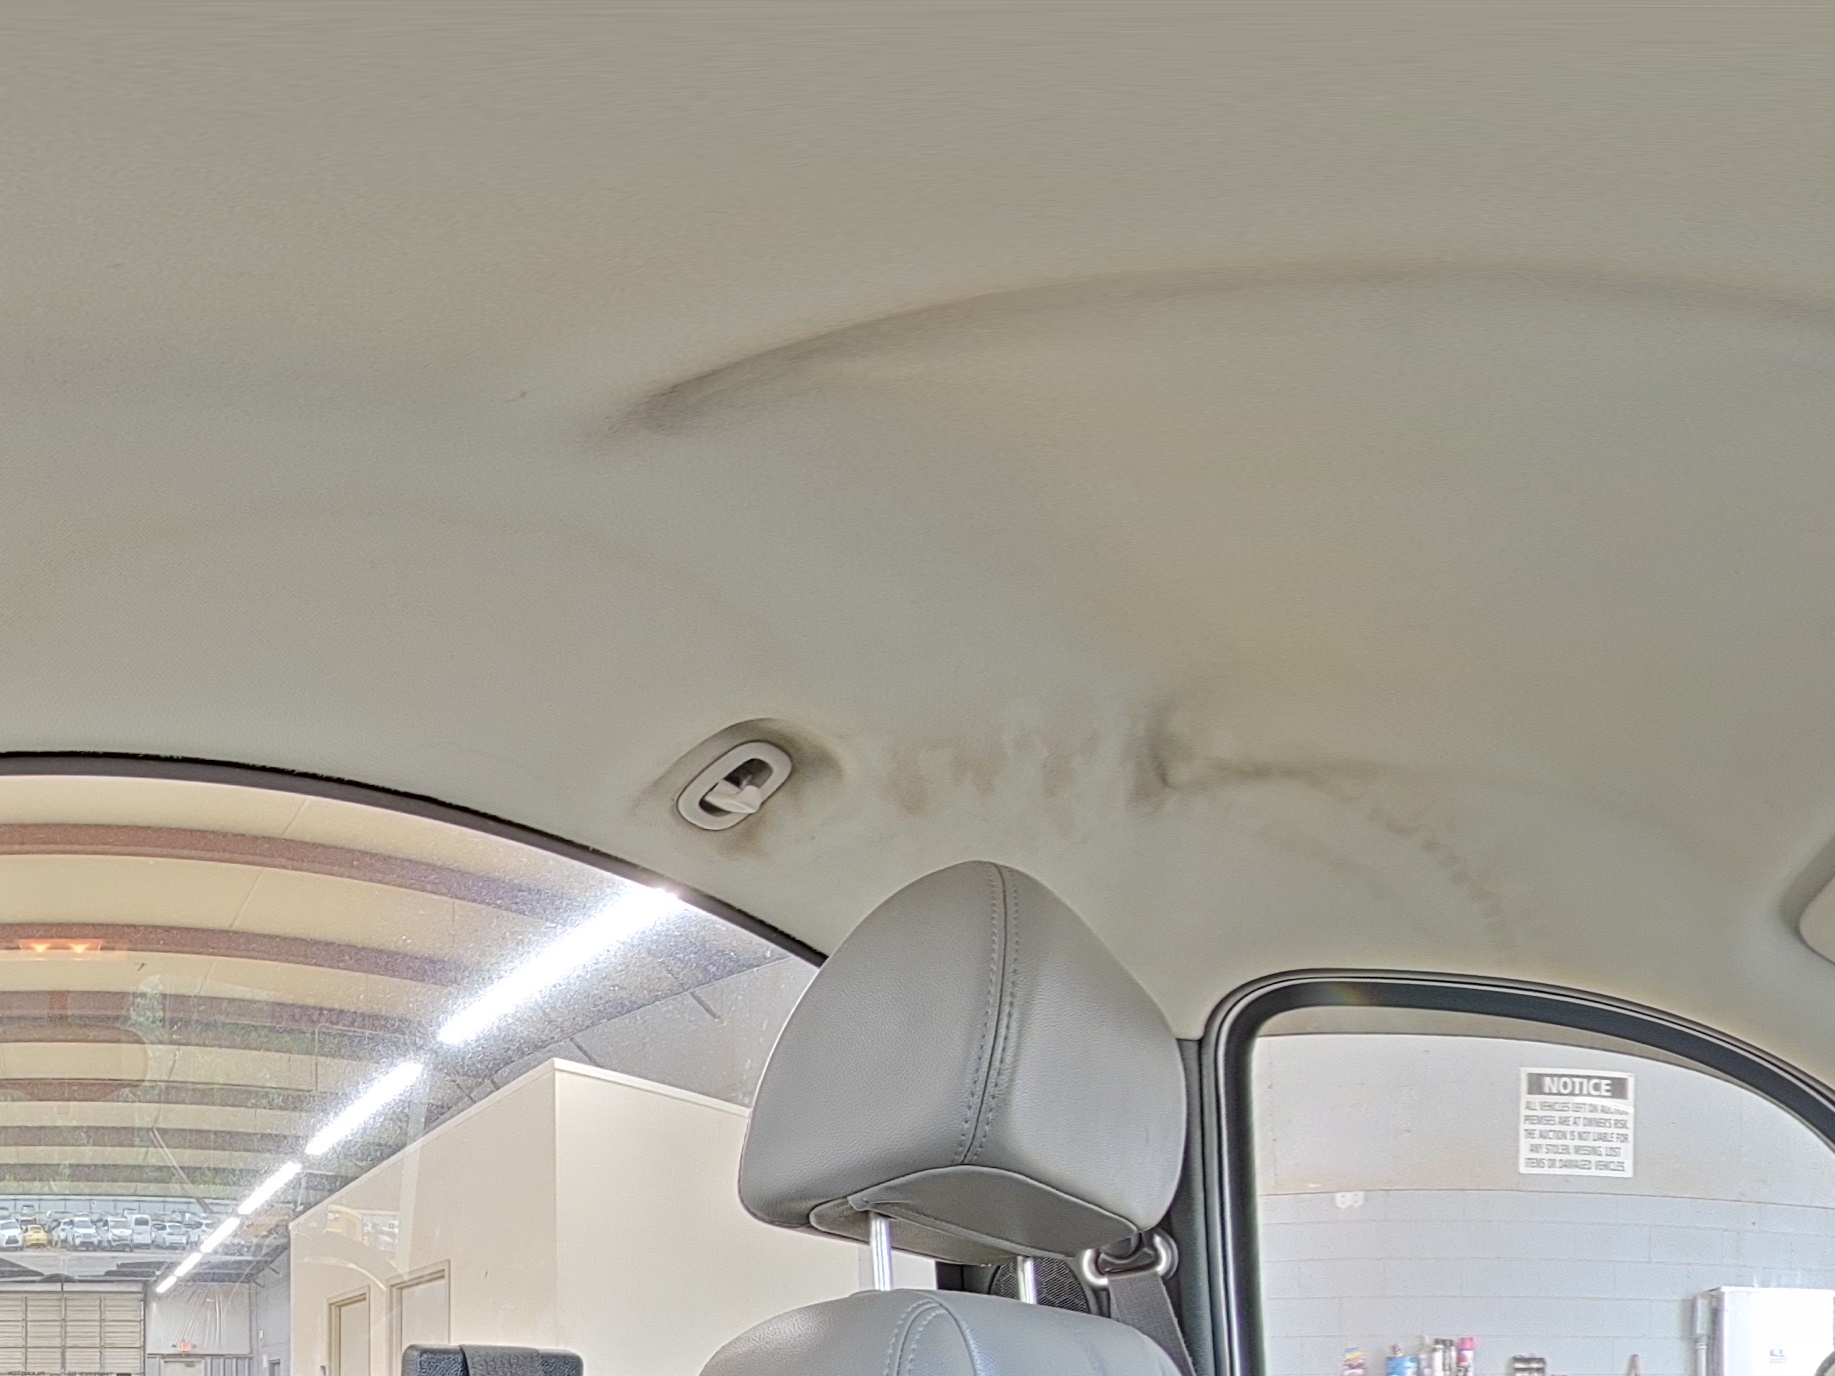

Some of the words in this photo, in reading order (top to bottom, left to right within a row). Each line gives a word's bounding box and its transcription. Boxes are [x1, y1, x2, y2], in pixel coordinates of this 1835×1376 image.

[1543, 1076, 1612, 1096] NOTICE
[1525, 1101, 1538, 1111] ALL
[1539, 1101, 1570, 1112] VEHICLES
[1571, 1102, 1587, 1113] LEFT
[1588, 1103, 1599, 1113] ON
[1523, 1115, 1556, 1126] PREMISES
[1558, 1116, 1572, 1126] ARE
[1572, 1116, 1582, 1126] AT
[1523, 1129, 1537, 1139] THE
[1538, 1129, 1568, 1140] AUCTION
[1568, 1130, 1576, 1140] IS
[1577, 1130, 1591, 1141] NOT
[1592, 1131, 1614, 1142] LIABLE
[1615, 1132, 1629, 1143] FOR
[1529, 1143, 1543, 1154] ANY
[1604, 1146, 1622, 1157] LOST
[1525, 1158, 1545, 1168] ITEMS
[1546, 1158, 1556, 1169] OR
[1557, 1158, 1592, 1170] DAMAGED
